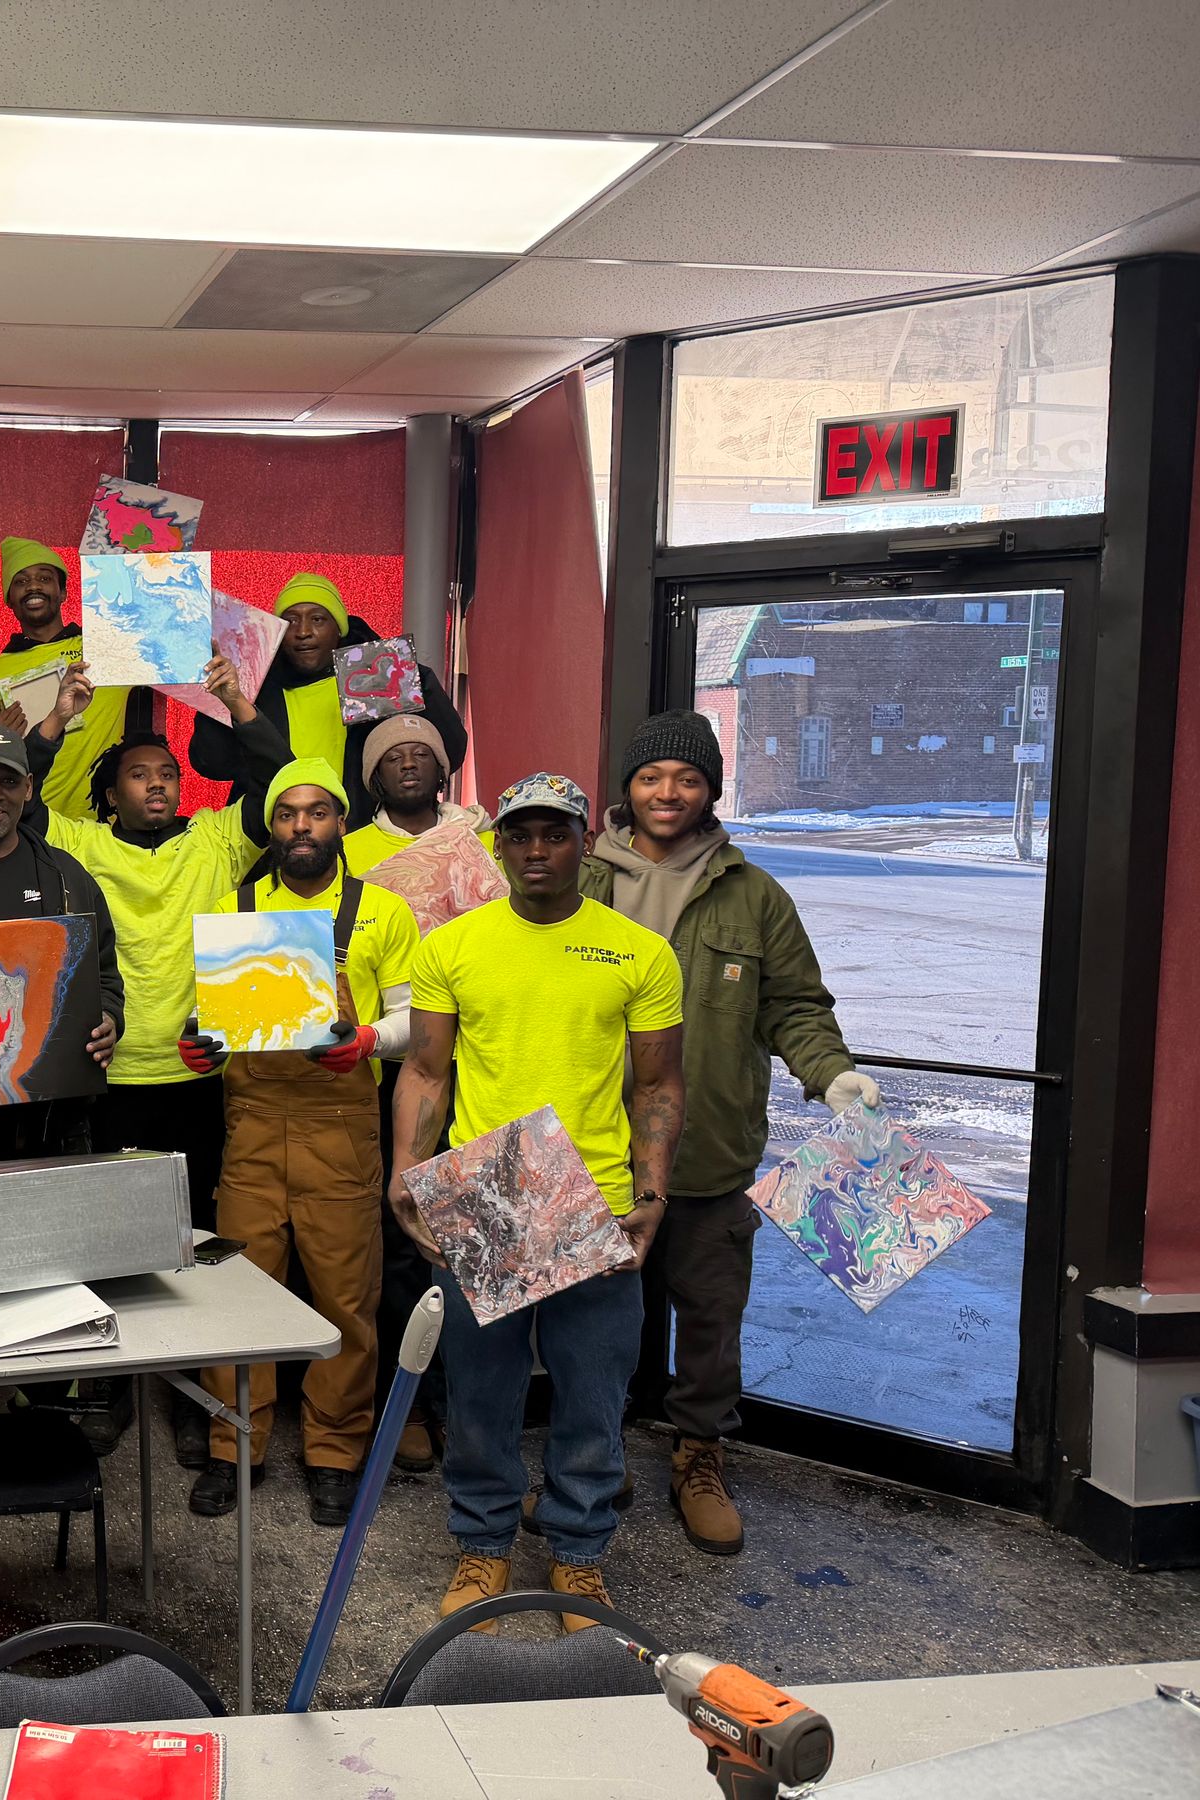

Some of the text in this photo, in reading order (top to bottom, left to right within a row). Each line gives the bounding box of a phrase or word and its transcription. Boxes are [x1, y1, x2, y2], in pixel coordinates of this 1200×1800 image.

[826, 416, 952, 496] EXIT
[1033, 688, 1047, 697] ONE
[1033, 698, 1047, 707] WAY
[564, 945, 635, 961] PARTICIPANT
[580, 954, 621, 967] LEADER
[694, 1704, 742, 1741] RIDGID
